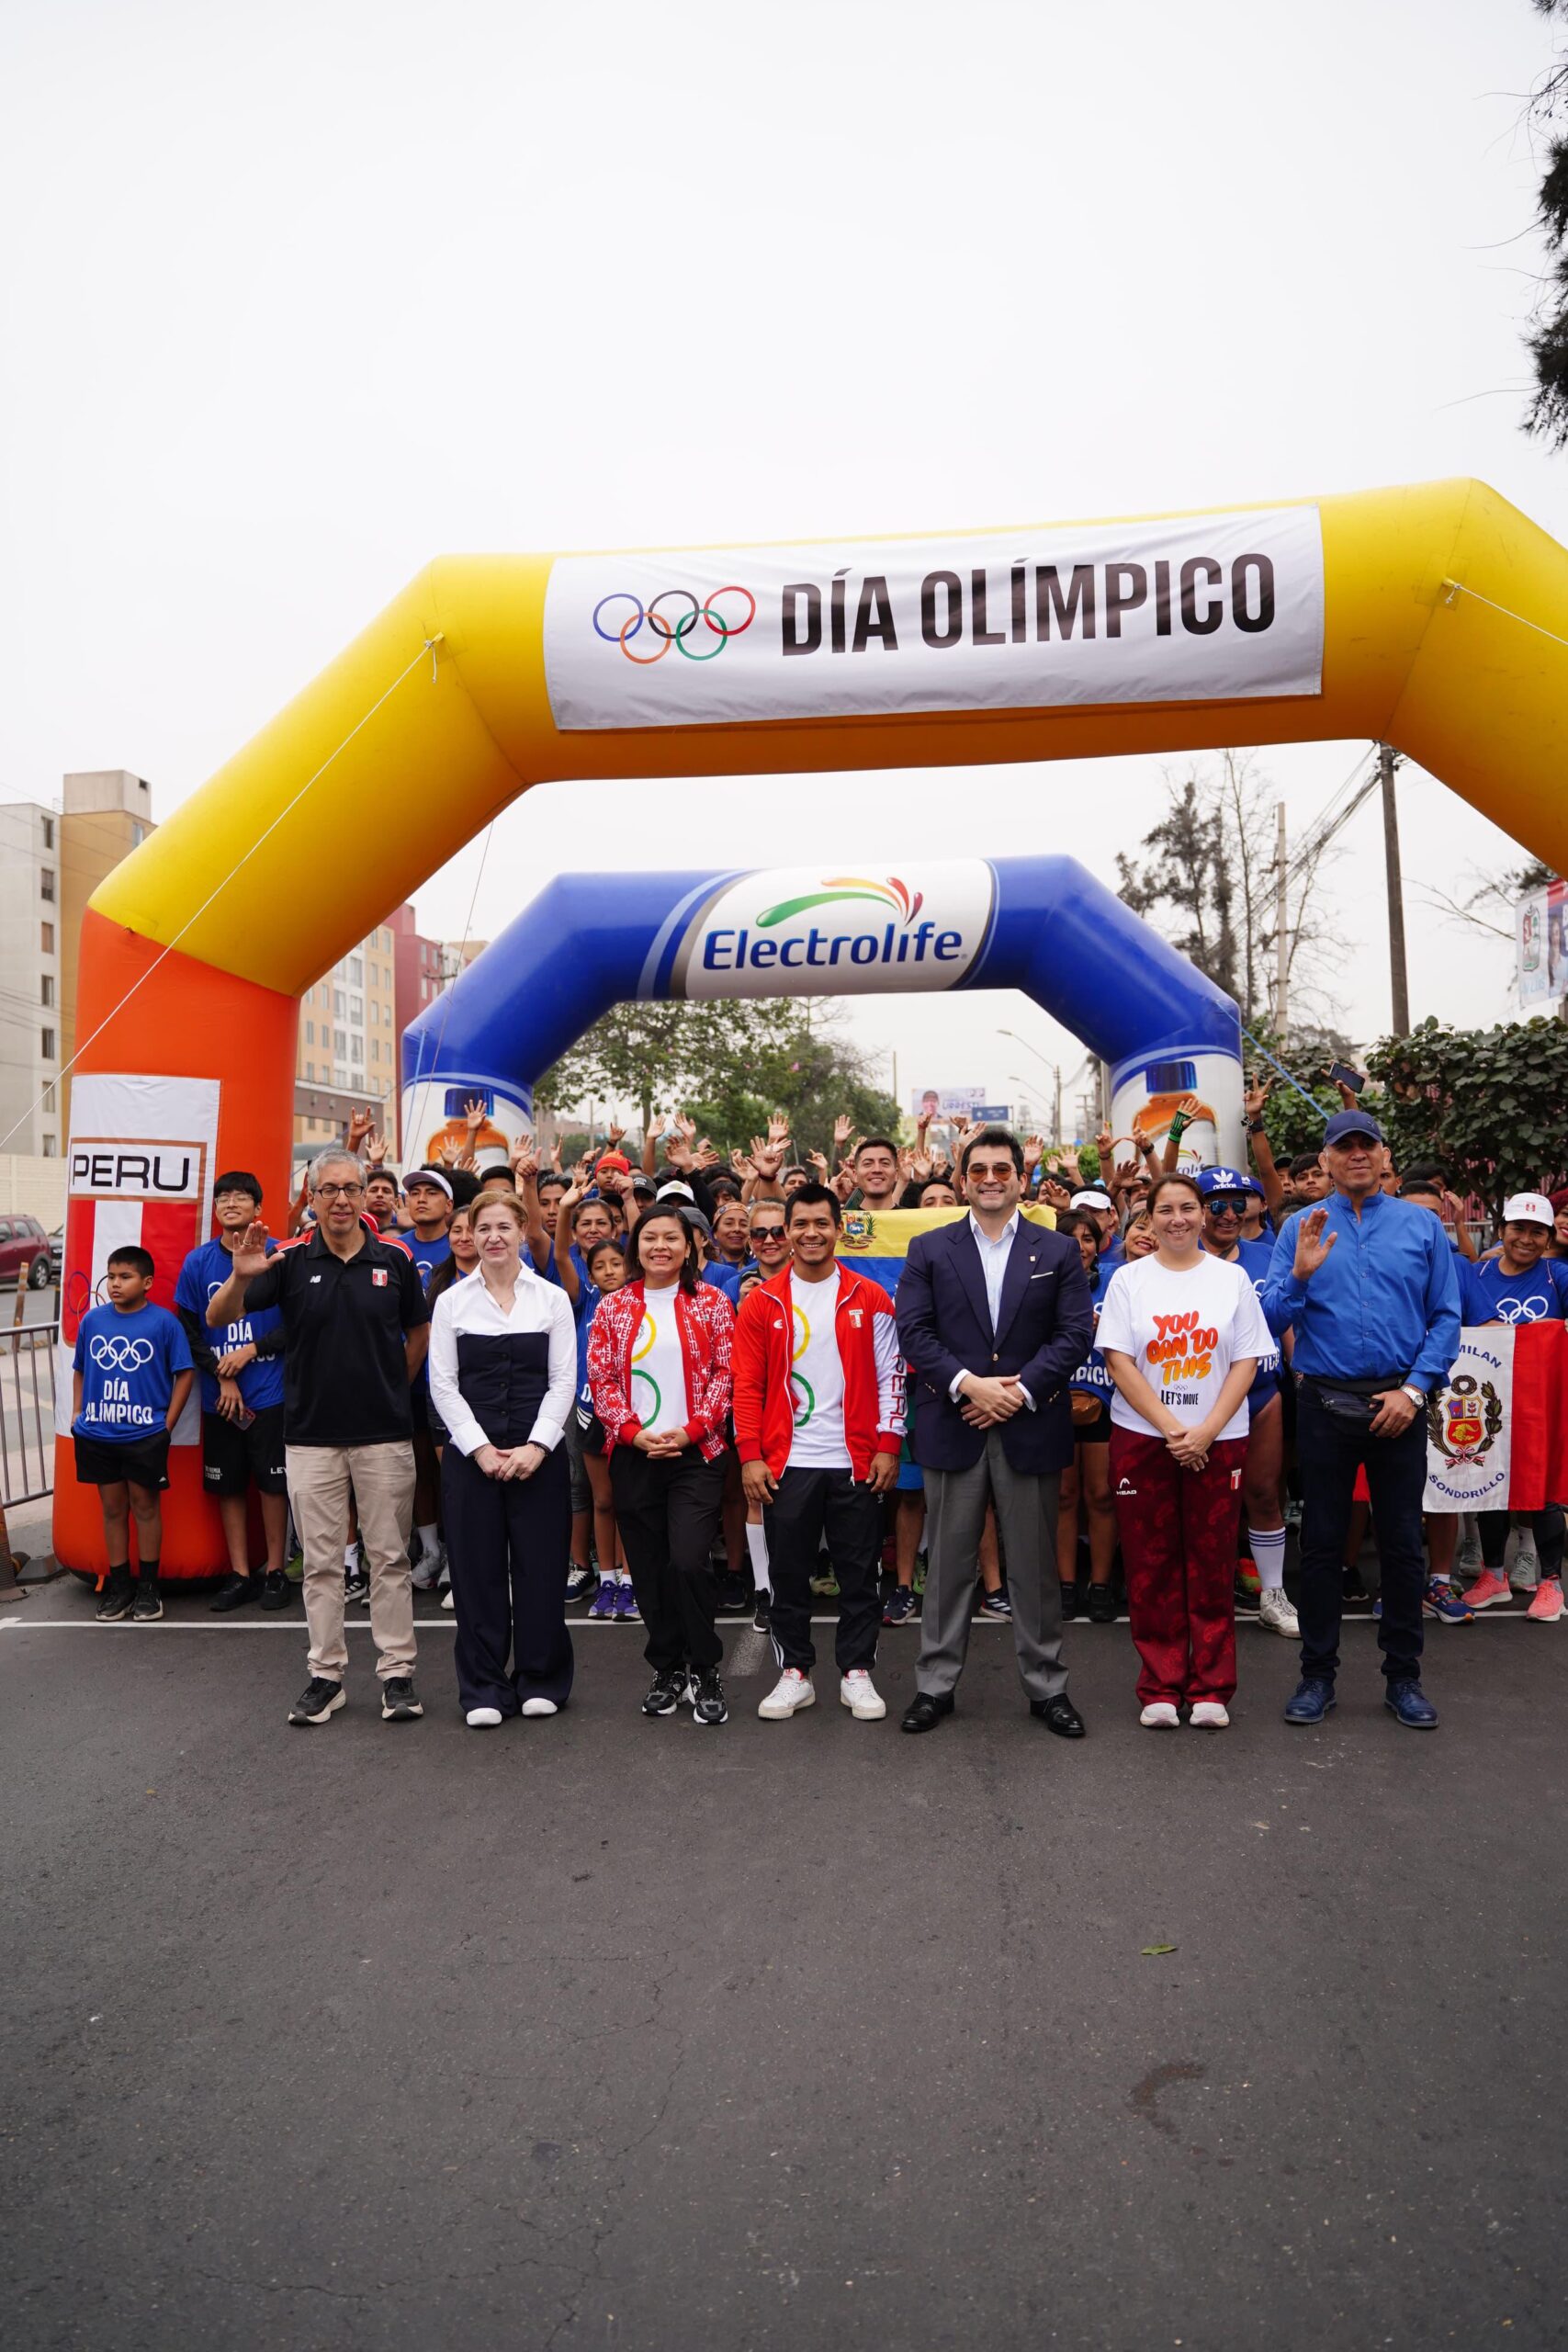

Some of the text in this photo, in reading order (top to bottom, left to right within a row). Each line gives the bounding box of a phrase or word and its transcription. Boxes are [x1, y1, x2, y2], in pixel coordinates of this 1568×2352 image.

[782, 553, 1275, 657] DÍA OLÍMPICO
[703, 922, 963, 970] Electrolife
[73, 1154, 190, 1192] PERU
[228, 1318, 253, 1342] DÍA
[1152, 1310, 1200, 1340] YOU
[1146, 1327, 1218, 1365] CAN DO
[1161, 1351, 1212, 1386] THIS
[103, 1377, 130, 1402] DÍA
[1161, 1389, 1199, 1405] LET'S MOVE
[1428, 1472, 1506, 1498] SONDORILLO
